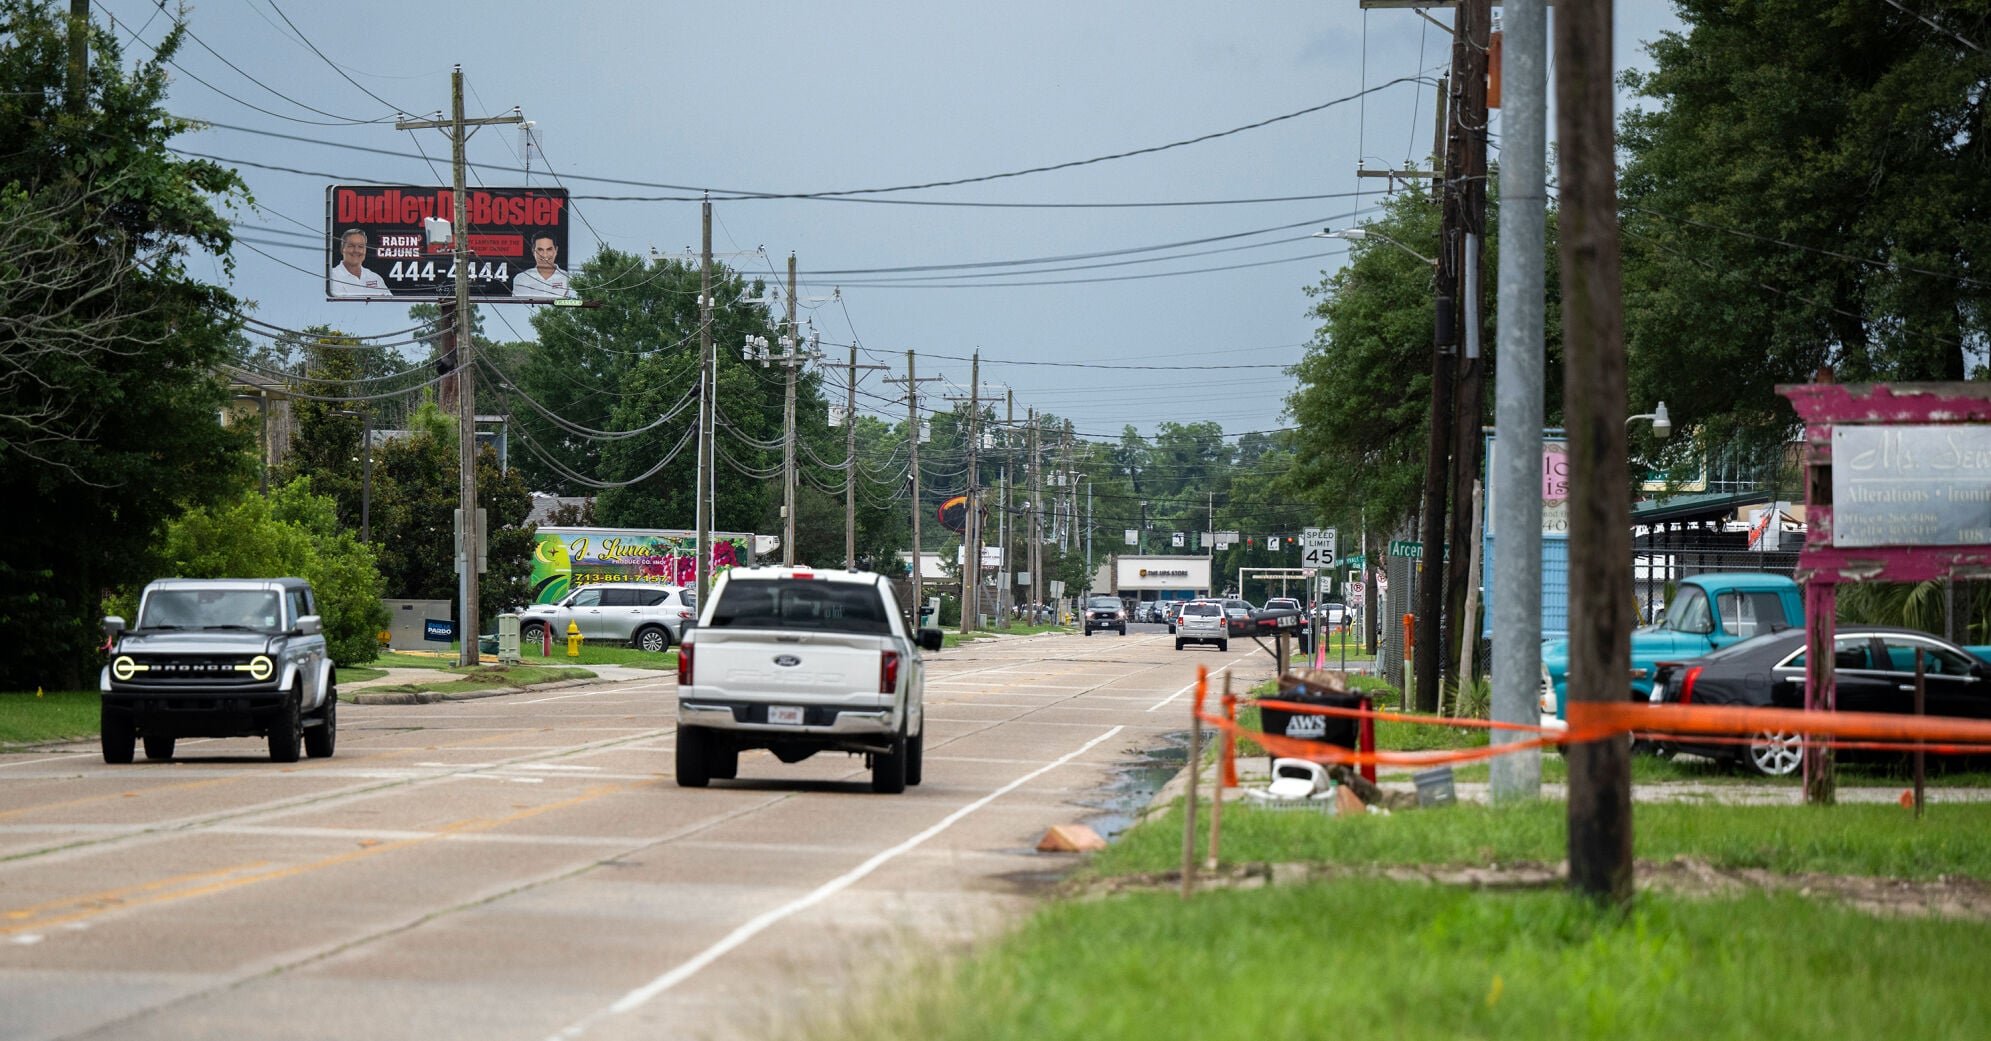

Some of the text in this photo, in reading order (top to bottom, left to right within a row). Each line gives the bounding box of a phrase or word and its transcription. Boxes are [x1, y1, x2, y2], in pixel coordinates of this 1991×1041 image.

[338, 190, 434, 227] Dudley
[377, 247, 420, 257] CAJUNS
[1847, 486, 1929, 503] Alterations
[597, 538, 652, 560] Luna
[1306, 549, 1333, 564] 45
[575, 573, 668, 583] 713-861-7157
[1287, 714, 1326, 730] AWS
